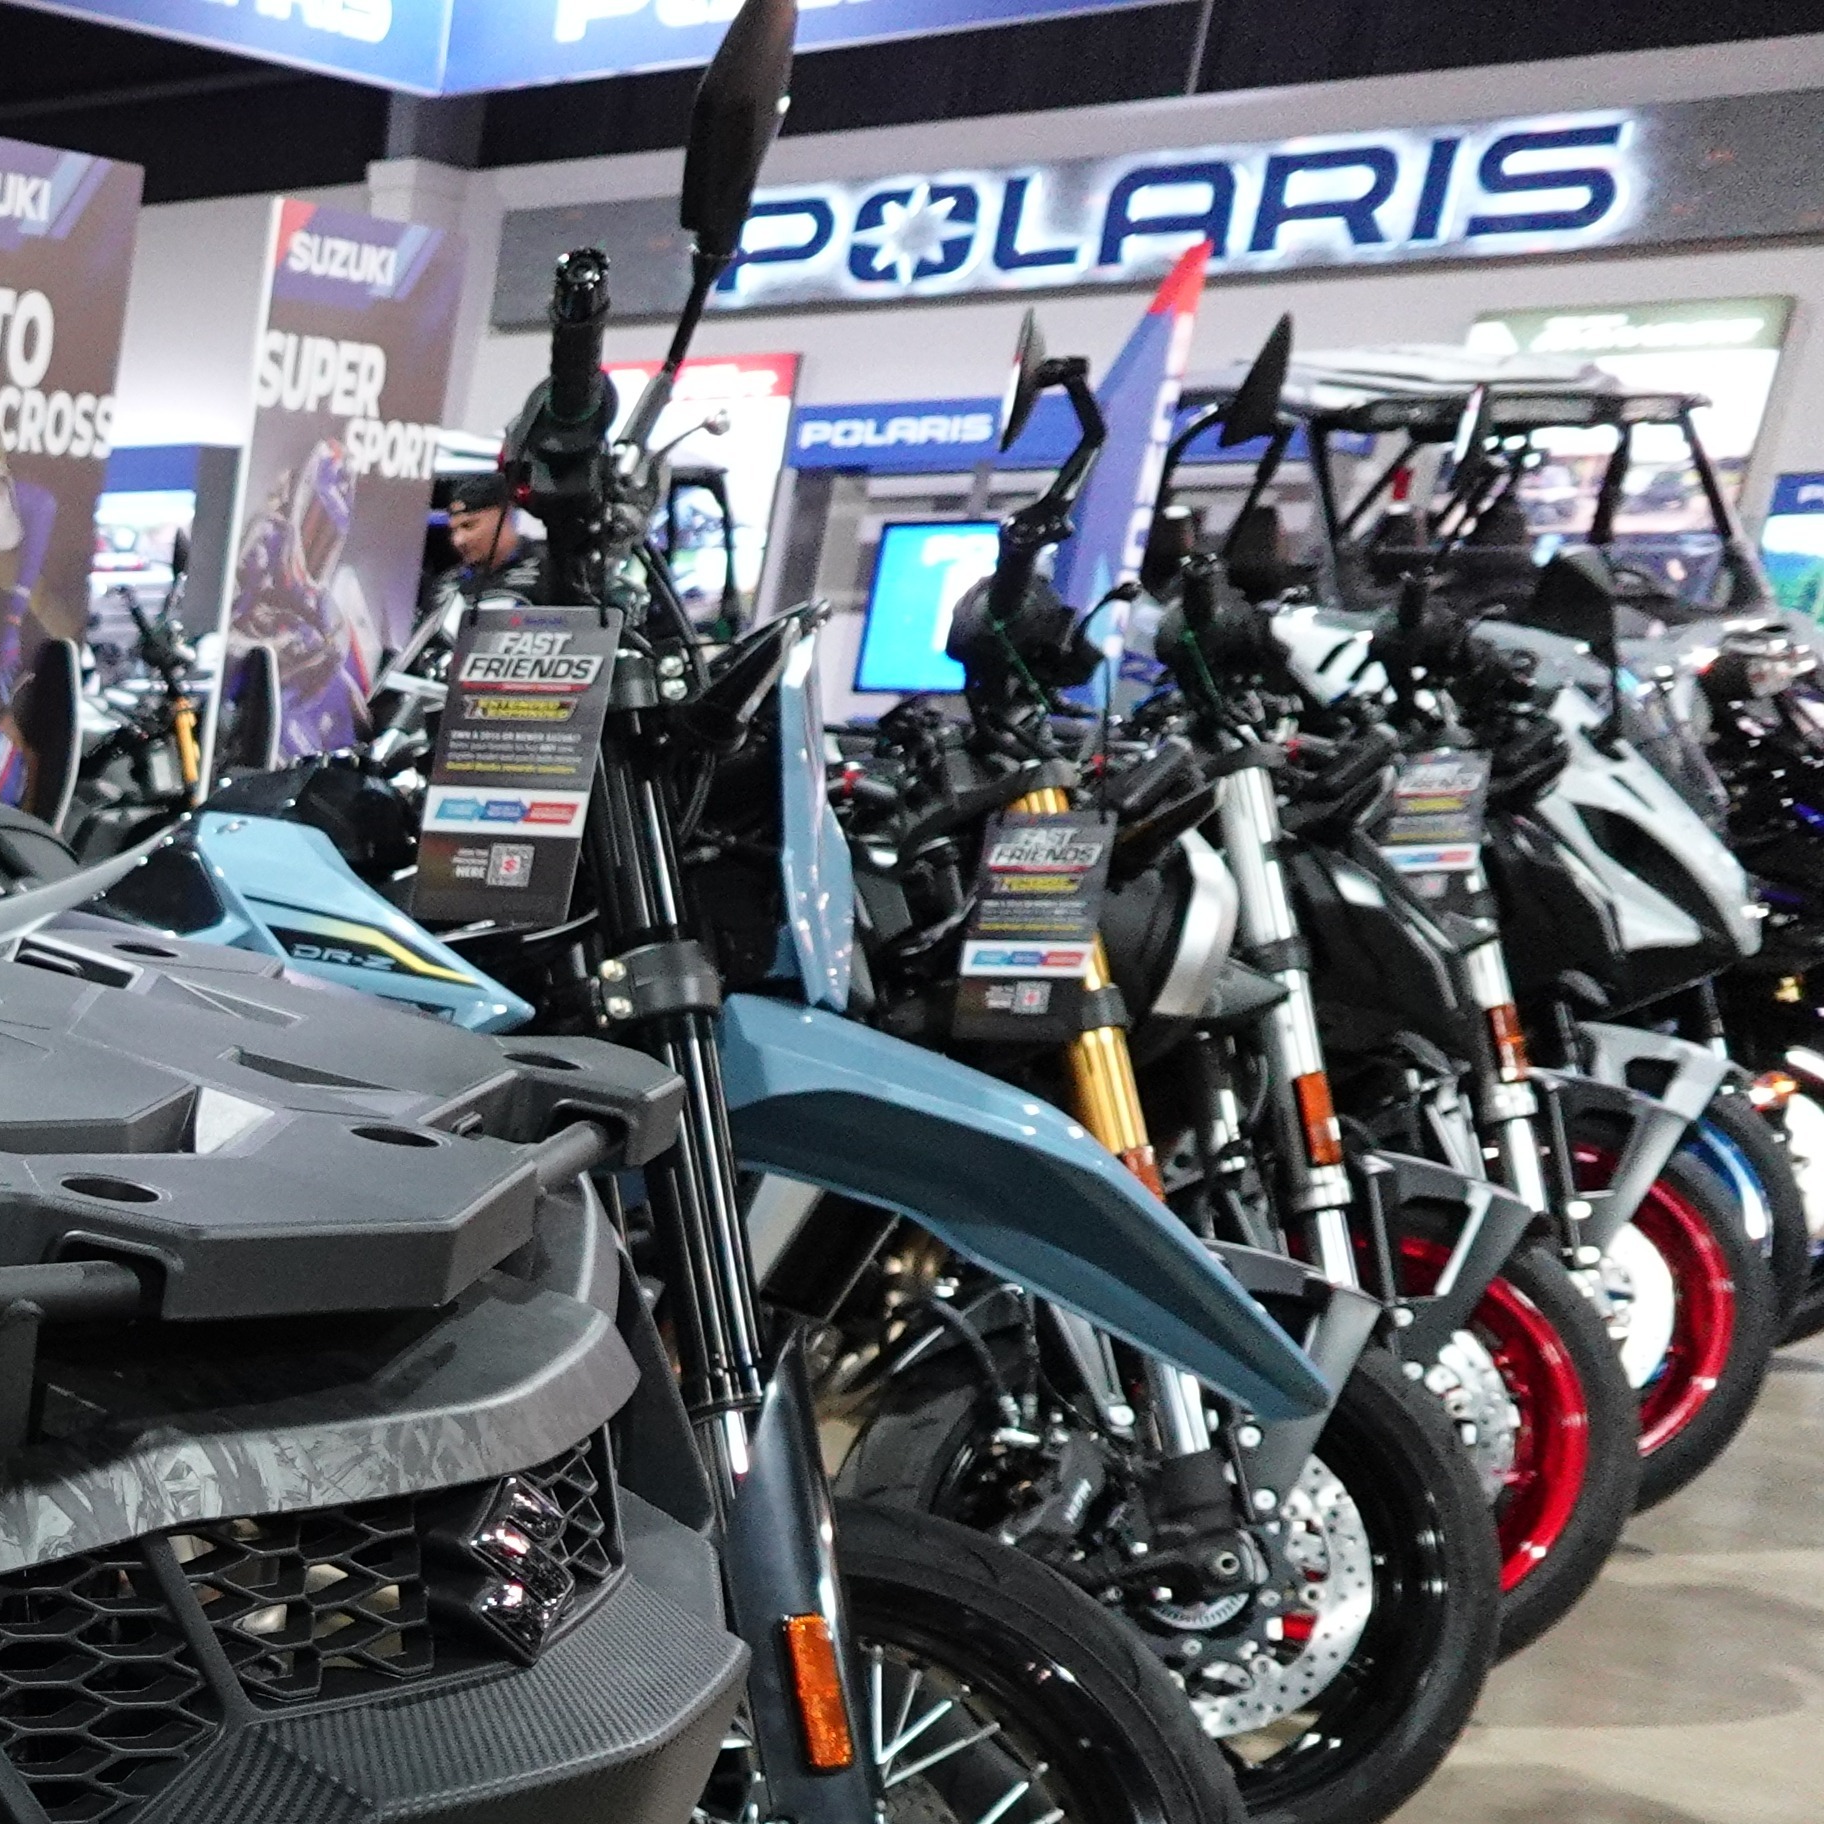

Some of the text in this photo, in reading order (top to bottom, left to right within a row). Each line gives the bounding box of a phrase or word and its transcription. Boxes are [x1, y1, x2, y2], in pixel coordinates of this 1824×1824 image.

[716, 122, 1625, 293] POLARIS
[287, 230, 399, 287] SUZUKI
[258, 329, 386, 416] SUPER
[348, 417, 439, 480] SPORT
[798, 412, 994, 449] POLARIS
[498, 631, 574, 656] FAST
[467, 657, 592, 680] FRIENDS
[292, 943, 397, 971] DR-Z
